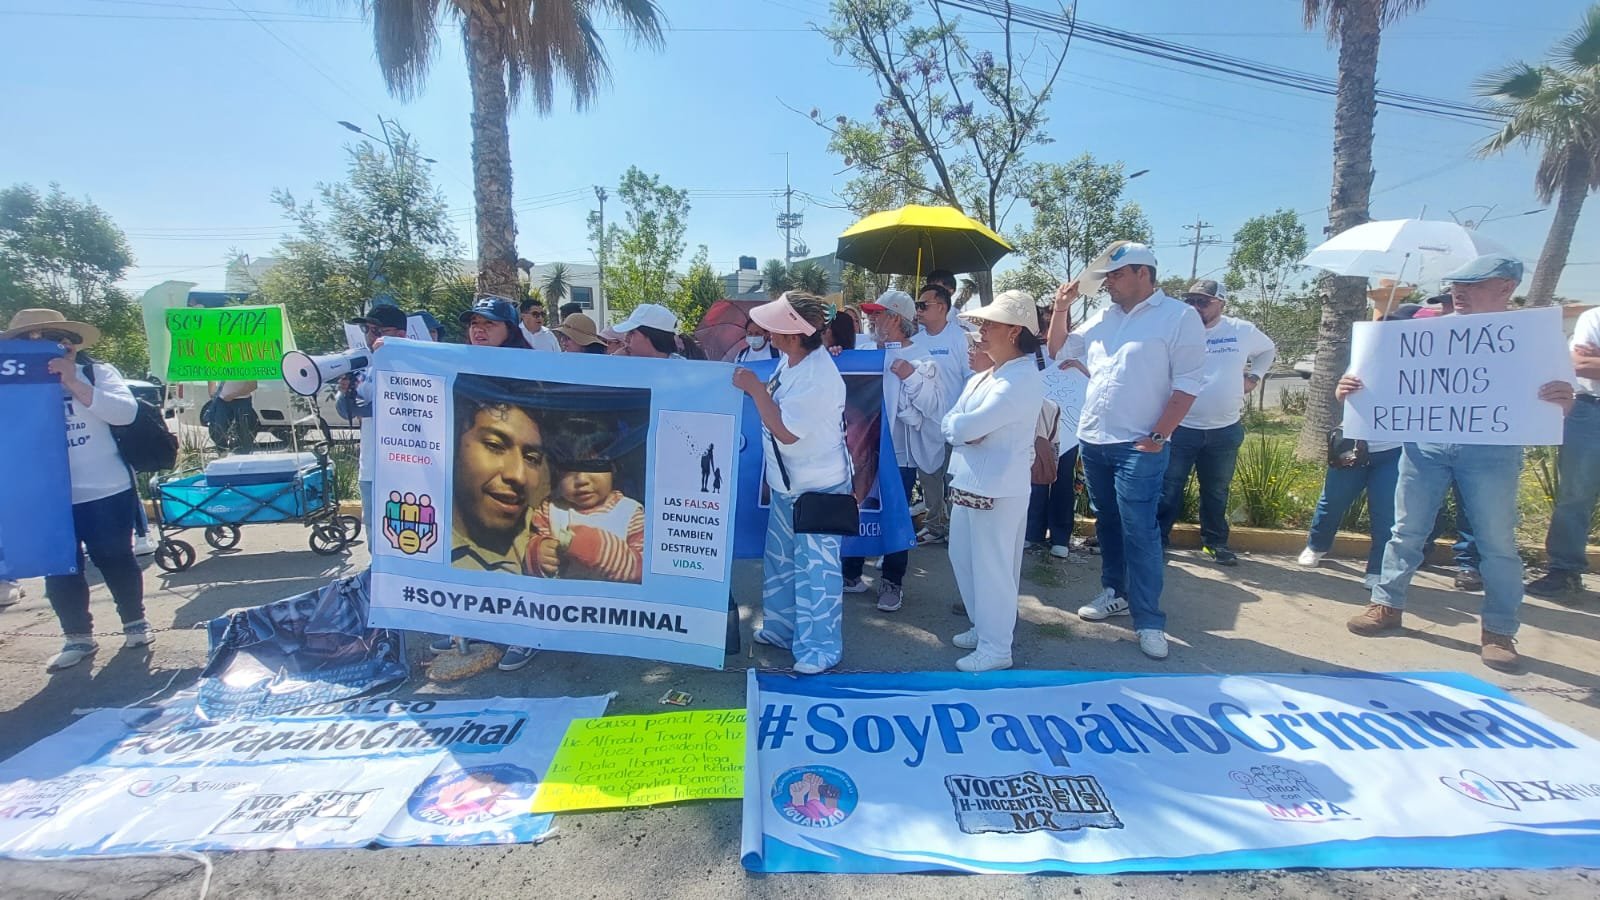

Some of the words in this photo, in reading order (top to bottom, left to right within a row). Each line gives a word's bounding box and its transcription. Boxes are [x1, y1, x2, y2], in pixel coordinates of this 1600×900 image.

[218, 308, 267, 335] PAPÁ
[1400, 331, 1434, 358] NO
[1448, 323, 1516, 356] MÁS
[390, 376, 432, 388] EXIGIMOS
[1398, 367, 1490, 395] NIÑOS
[384, 391, 425, 403] REVISION
[427, 395, 439, 404] DE
[389, 406, 433, 419] CARPETAS
[1373, 405, 1509, 433] REHENES
[402, 423, 421, 433] CON
[381, 436, 427, 449] IGUALDAD
[429, 441, 441, 450] DE
[388, 452, 433, 465] DERECHO.
[664, 497, 682, 507] LAS
[684, 499, 720, 511] FALSAS
[662, 512, 720, 526] DENUNCIAS
[667, 527, 713, 541] TAMBIEN
[661, 542, 718, 557] DESTRUYEN
[672, 558, 705, 571] VIDAS.
[585, 716, 636, 730] Causa
[757, 700, 1578, 768] #SoyPapáNoCriminal
[952, 777, 1043, 798] VOCES
[960, 795, 1053, 812] H-INOCENTES
[1263, 800, 1352, 818] MAPA
[783, 806, 845, 828] IGUALDAD
[1010, 810, 1061, 830] MX
